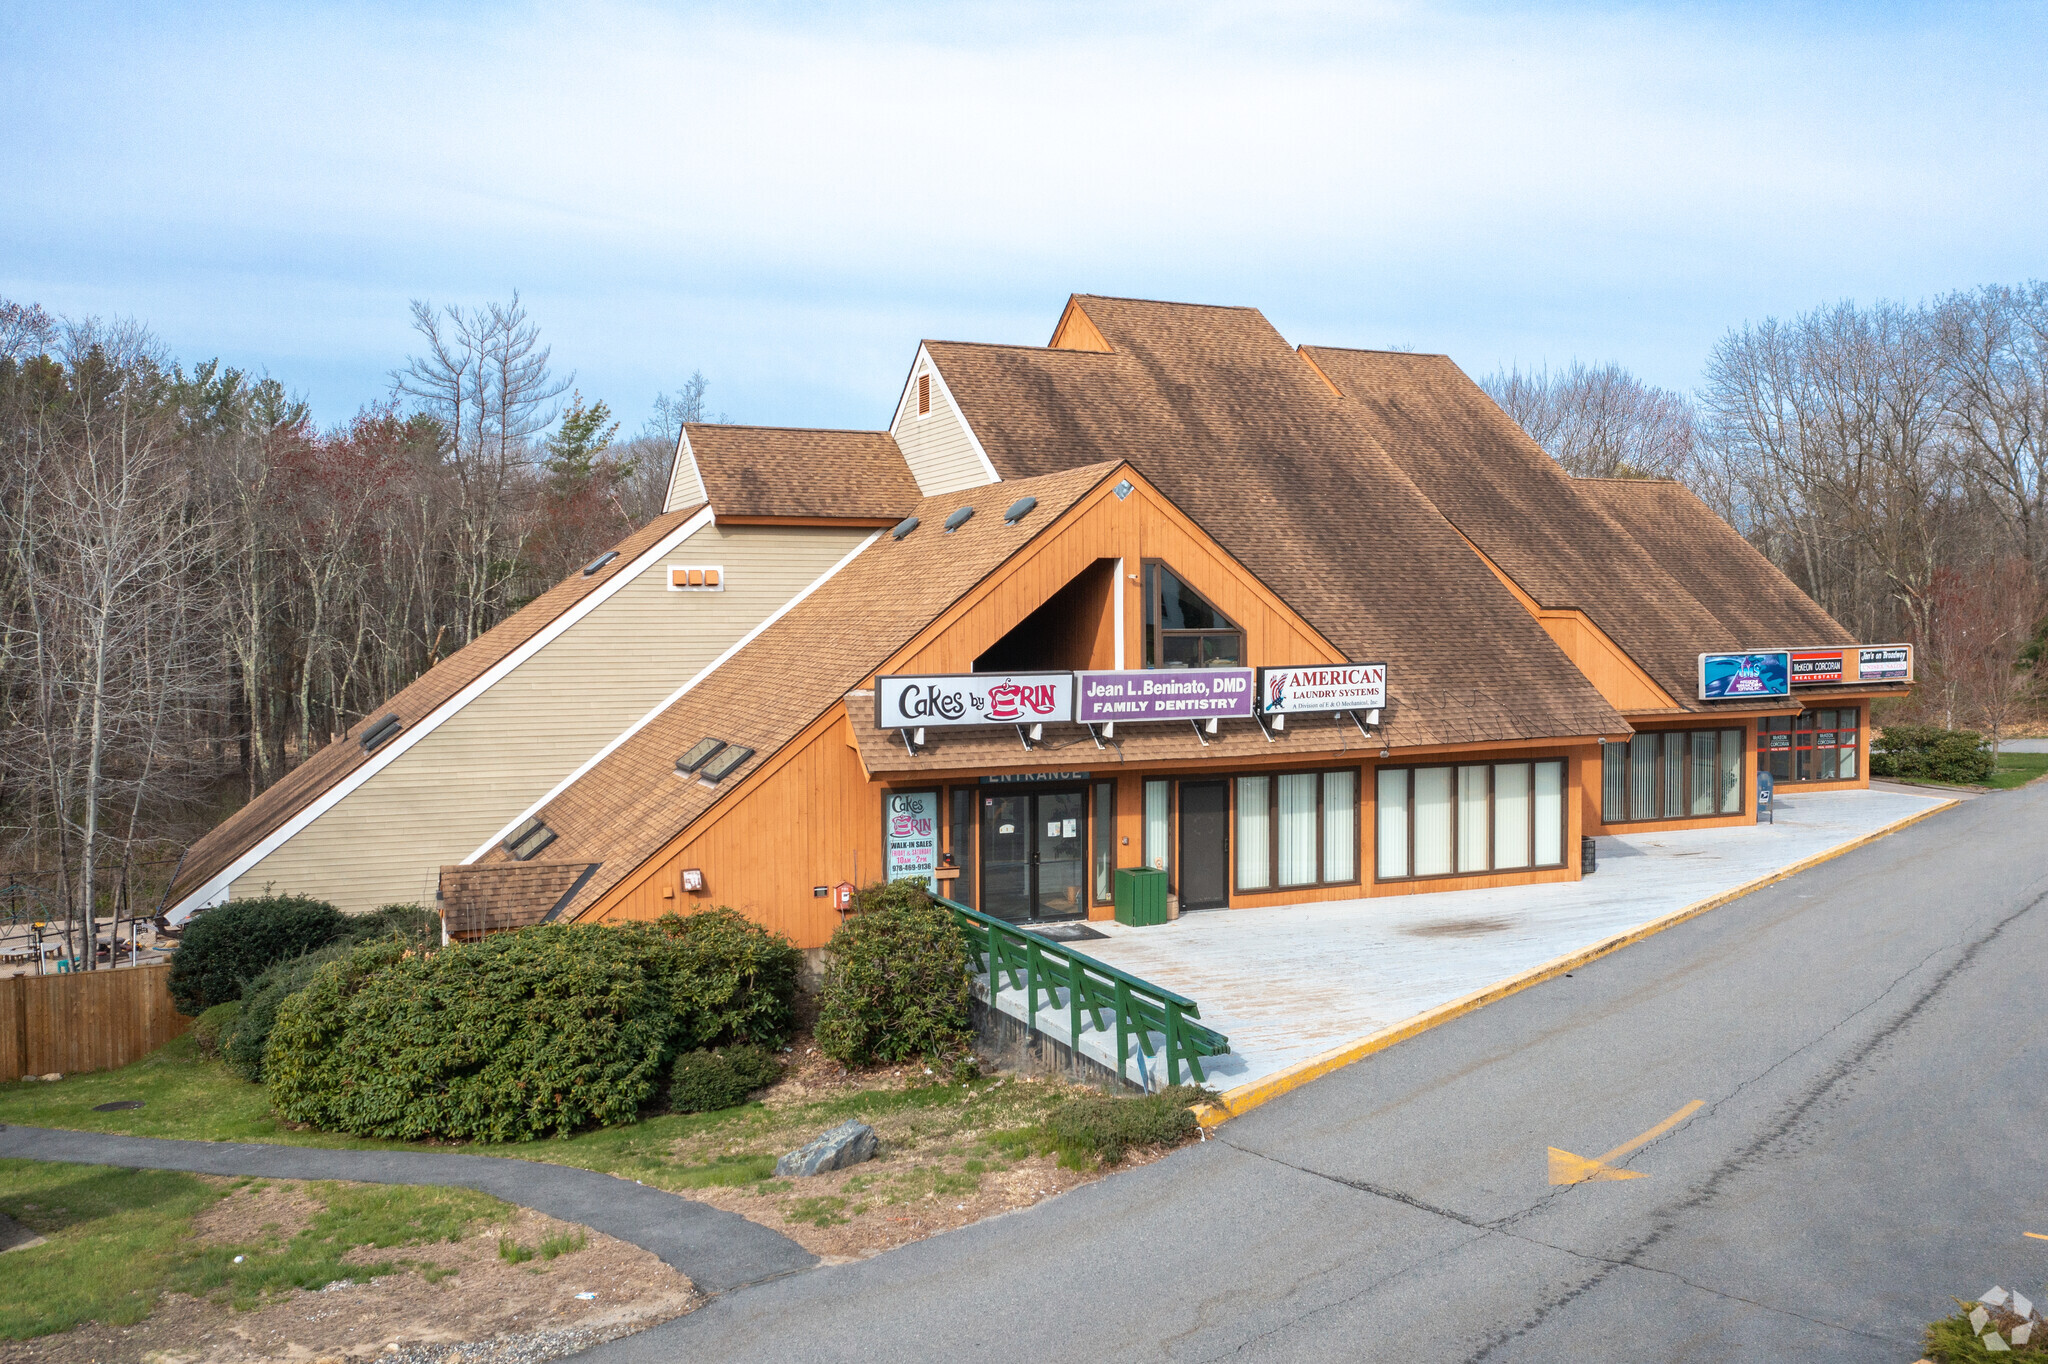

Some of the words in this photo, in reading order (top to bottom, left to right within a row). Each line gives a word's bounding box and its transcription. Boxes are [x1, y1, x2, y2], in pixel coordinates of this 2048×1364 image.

[1882, 651, 1906, 661] Broadway
[1793, 663, 1813, 672] McKEON
[1814, 661, 1841, 671] CORCORAN
[1290, 669, 1383, 687] AMERICAN
[1087, 681, 1123, 697] Jean
[1213, 677, 1247, 693] DMD
[1294, 690, 1337, 699] LAUNDRY
[1339, 688, 1379, 697] SYSTEMS
[898, 684, 966, 721] Cakes
[969, 692, 984, 711] by
[1093, 701, 1148, 713] FAMILY
[1154, 698, 1238, 711] DENTISTRY
[892, 796, 924, 814] Cakes
[891, 841, 915, 849] WALK-IN
[916, 840, 932, 848] SALES
[911, 848, 932, 856] SATURDAY
[892, 864, 931, 872] 978-469-9136
